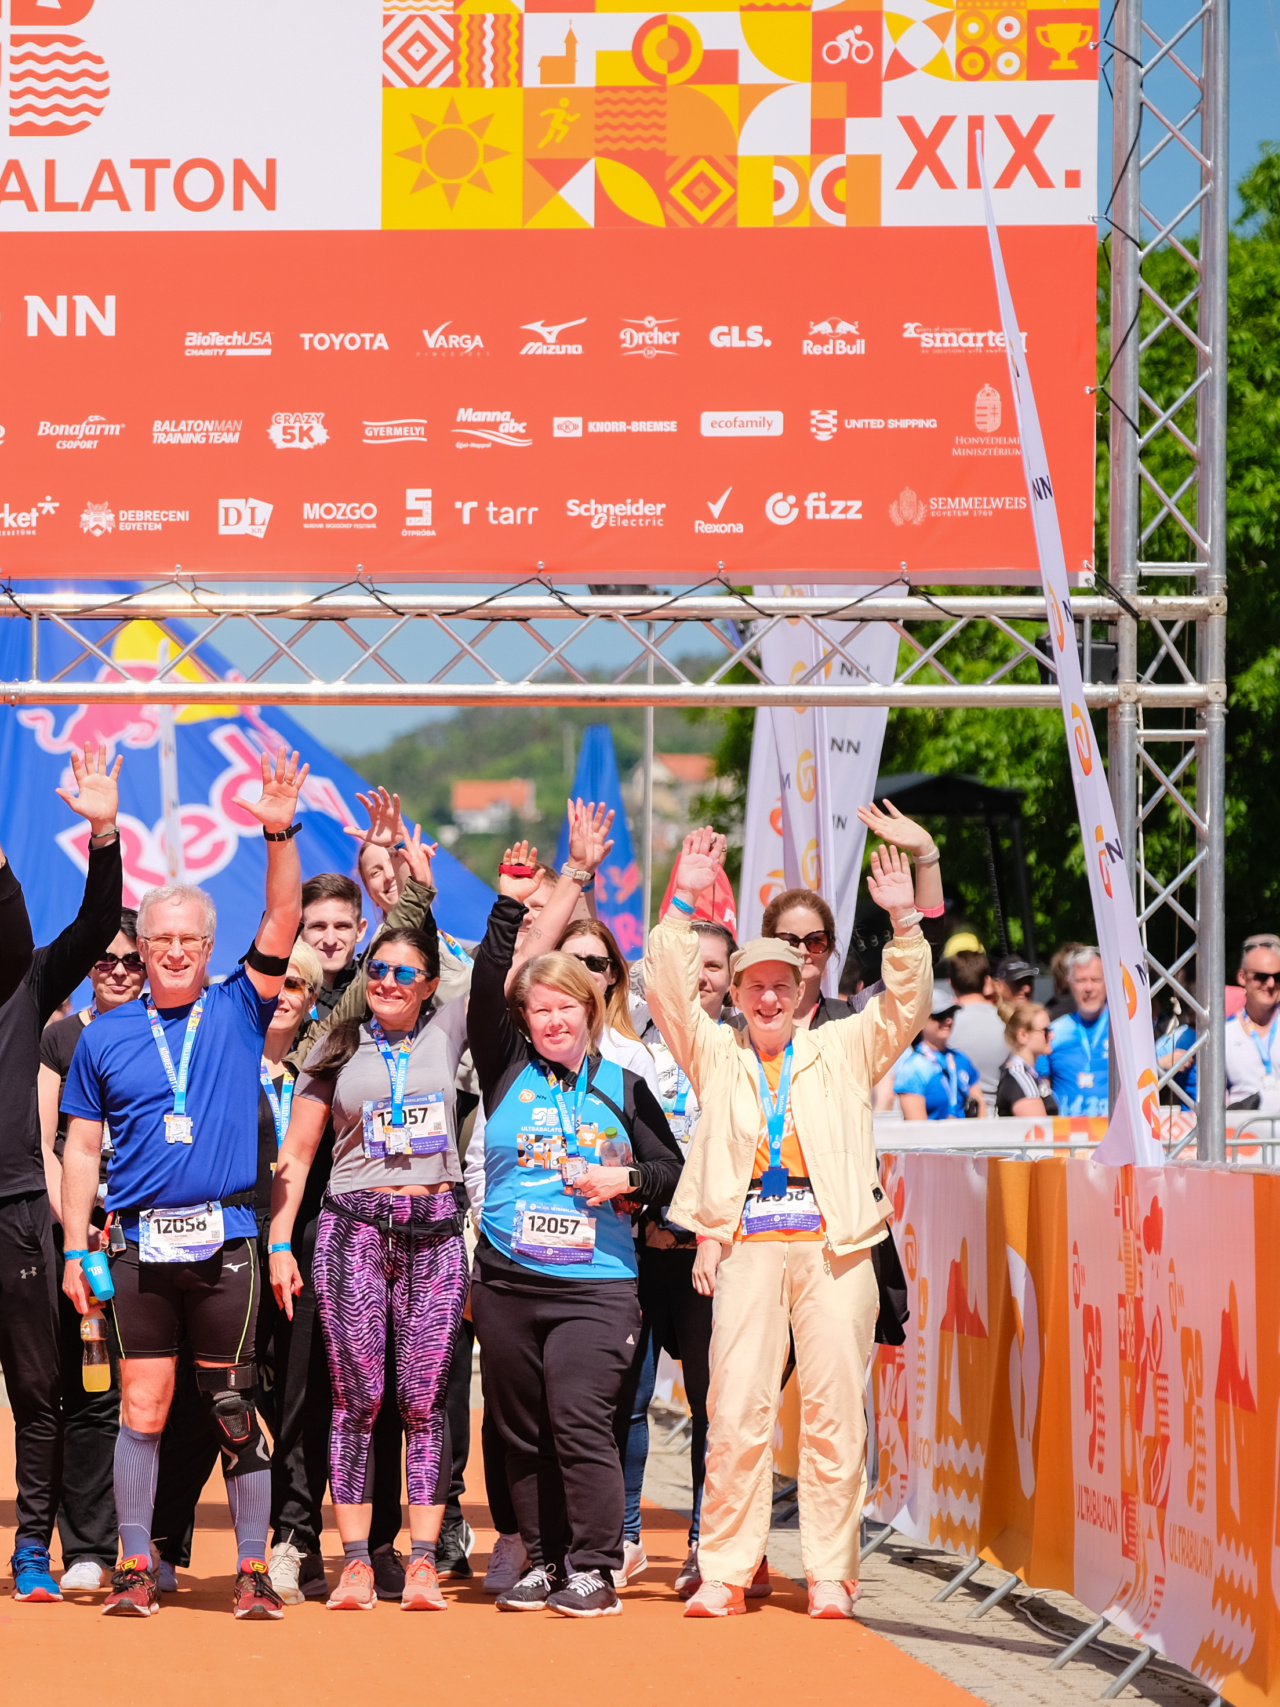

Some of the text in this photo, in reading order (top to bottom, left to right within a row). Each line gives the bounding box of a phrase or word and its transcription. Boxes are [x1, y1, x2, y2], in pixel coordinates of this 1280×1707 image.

[895, 114, 1082, 190] XIX.
[24, 294, 116, 337] NN
[184, 331, 272, 346] BioTechUSA
[300, 332, 390, 351] TOYOTA
[422, 321, 484, 354] VARGA
[620, 326, 681, 349] Dreher
[709, 325, 772, 348] GLS.
[184, 348, 225, 357] CHARITY
[802, 338, 866, 355] Red Bull
[272, 412, 325, 425] CRAZY
[456, 408, 511, 422] Manna
[37, 419, 121, 437] Bonafarm
[153, 420, 243, 432] BALATONMAN
[499, 419, 527, 433] abc
[588, 421, 678, 432] KNORR-BREMSE
[710, 416, 774, 431] ecofamily
[844, 418, 938, 429] UNITED SHIPPING
[152, 432, 240, 444] TRAINING TEAM
[281, 425, 315, 444] 5K
[365, 426, 425, 437] GYERMELYI
[56, 440, 99, 449] CSOPORT
[566, 498, 666, 517] Schneider
[804, 492, 862, 520] fizz
[929, 496, 1027, 510] SEMMELWEIS
[119, 510, 190, 522] DEBRECENI
[303, 502, 378, 520] MOZGO
[486, 501, 539, 525] tarr
[119, 522, 162, 531] EGYETEM
[608, 515, 664, 528] Electric
[694, 520, 744, 534] Rexona
[401, 528, 437, 537] ÖTPRÓBA
[831, 737, 861, 755] NN
[153, 1216, 208, 1235] 12058
[528, 1215, 580, 1236] 12057
[1169, 1521, 1214, 1578] ULTRABALATON
